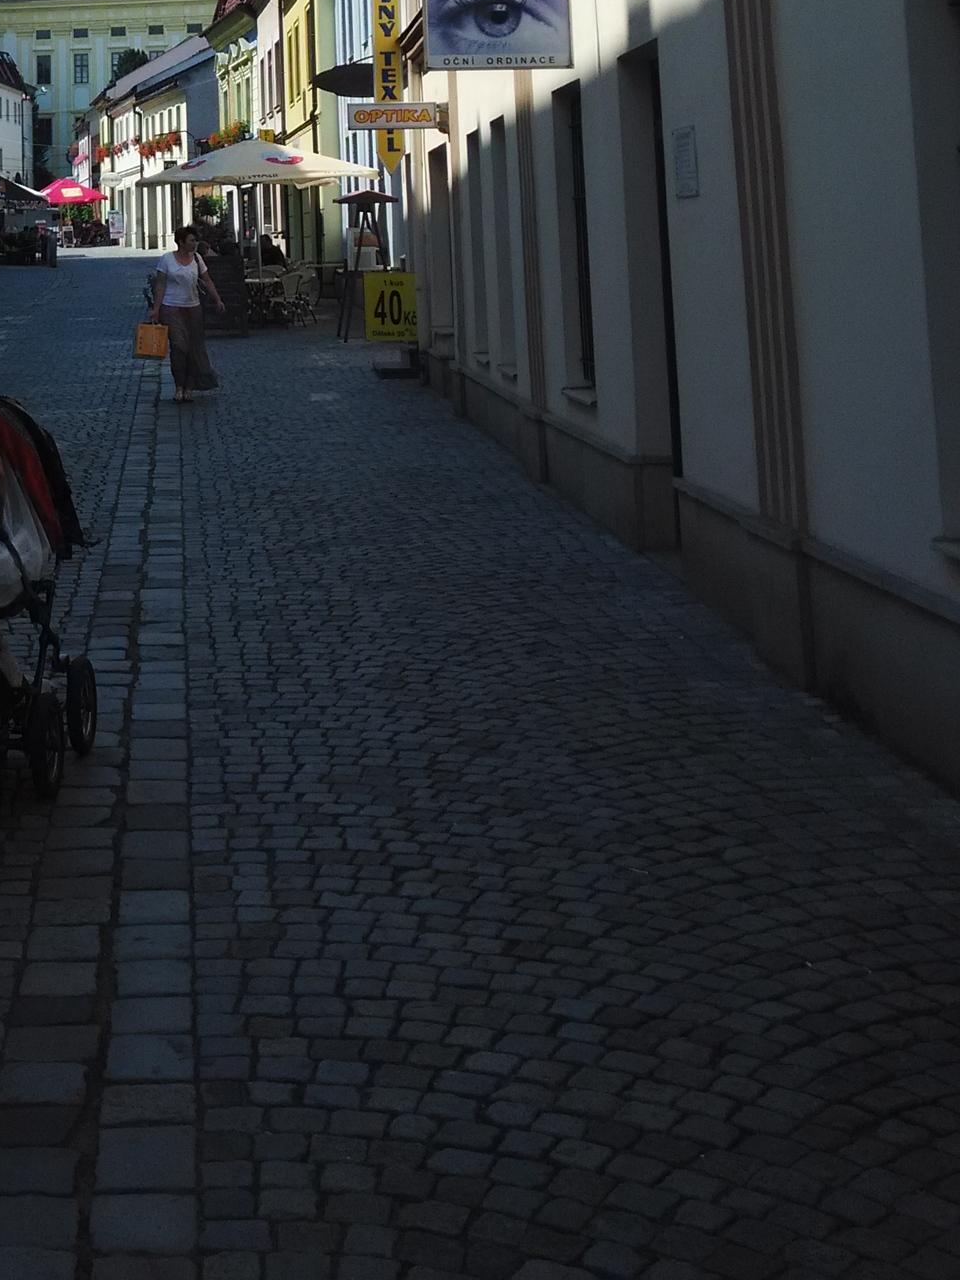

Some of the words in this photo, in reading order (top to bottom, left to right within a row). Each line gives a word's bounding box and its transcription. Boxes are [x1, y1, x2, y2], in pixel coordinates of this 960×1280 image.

[443, 56, 475, 66] OČNÍ
[486, 55, 556, 65] ORDINACE
[380, 51, 401, 152] TEXL
[354, 108, 432, 124] OPTIKA
[374, 289, 403, 325] 40
[403, 310, 417, 326] Kč
